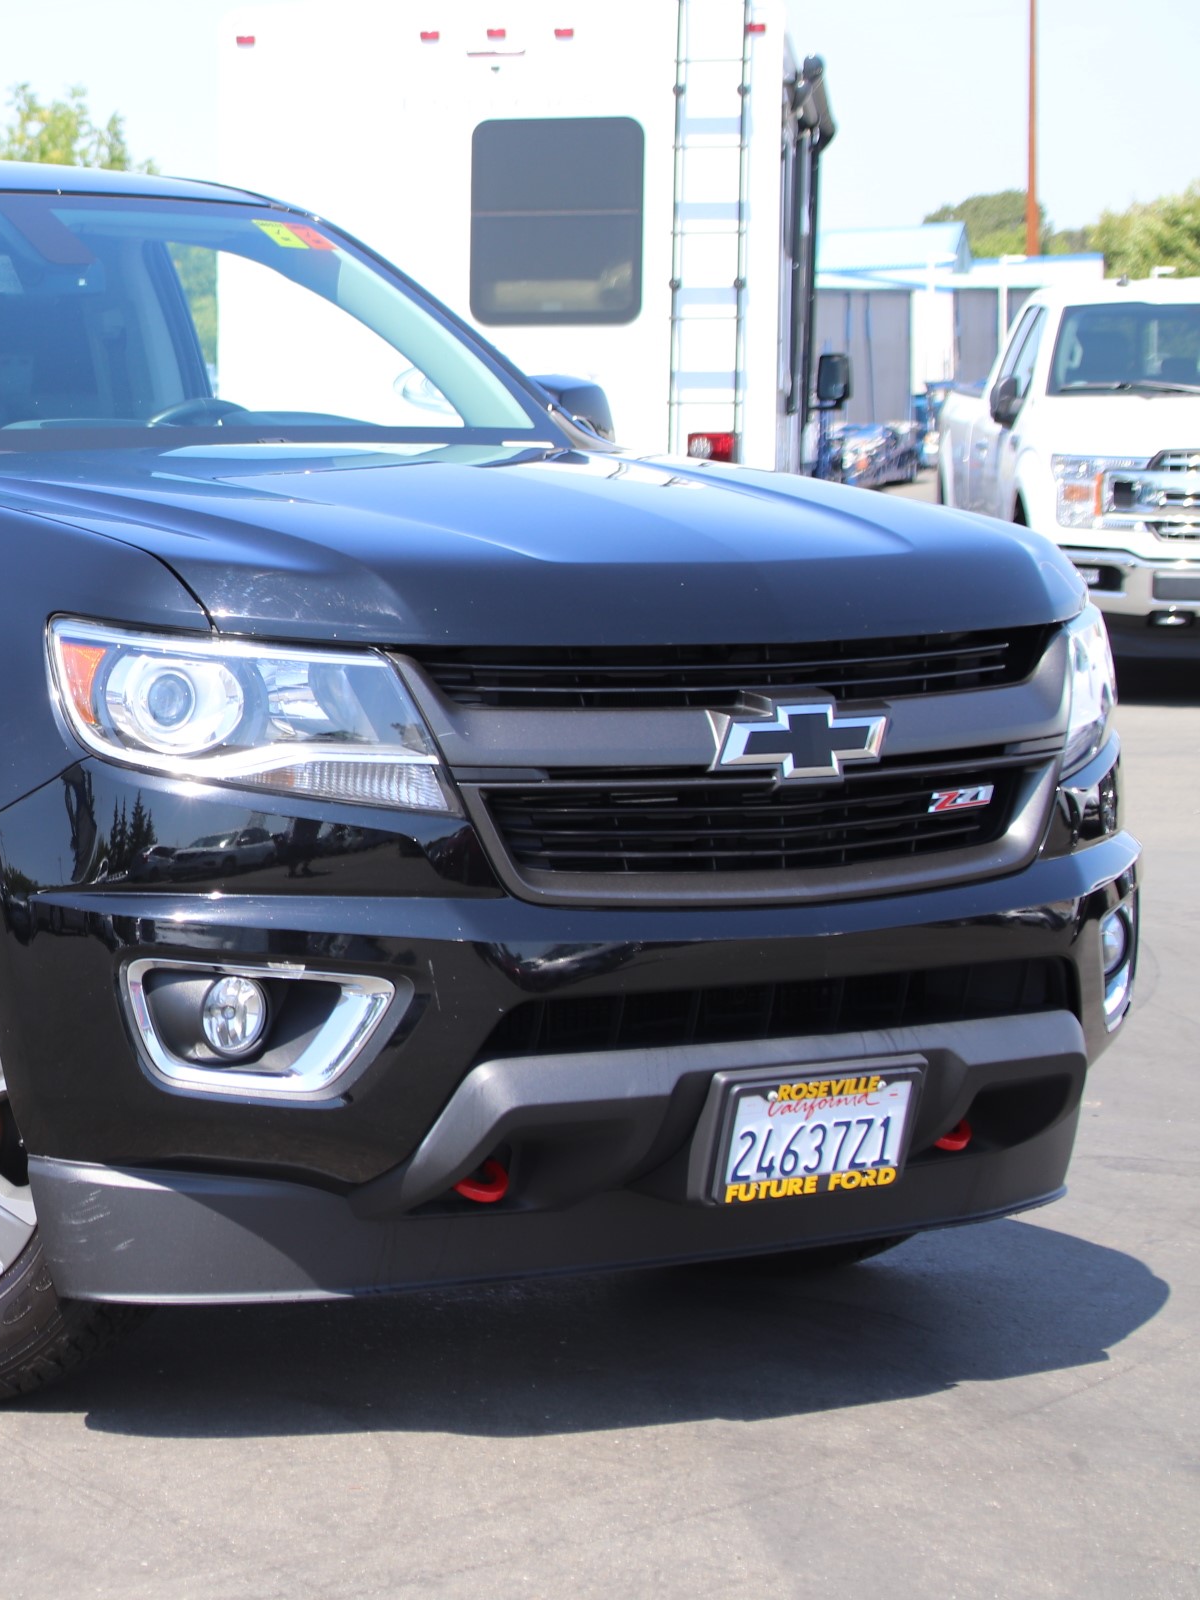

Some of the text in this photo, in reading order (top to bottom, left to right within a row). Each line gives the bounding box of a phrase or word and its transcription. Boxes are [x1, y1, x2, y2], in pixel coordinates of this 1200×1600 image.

[928, 785, 994, 813] Z71
[777, 1076, 881, 1102] ROSEVILLE
[767, 1091, 881, 1121] California
[725, 1167, 896, 1203] FUTURE FORD
